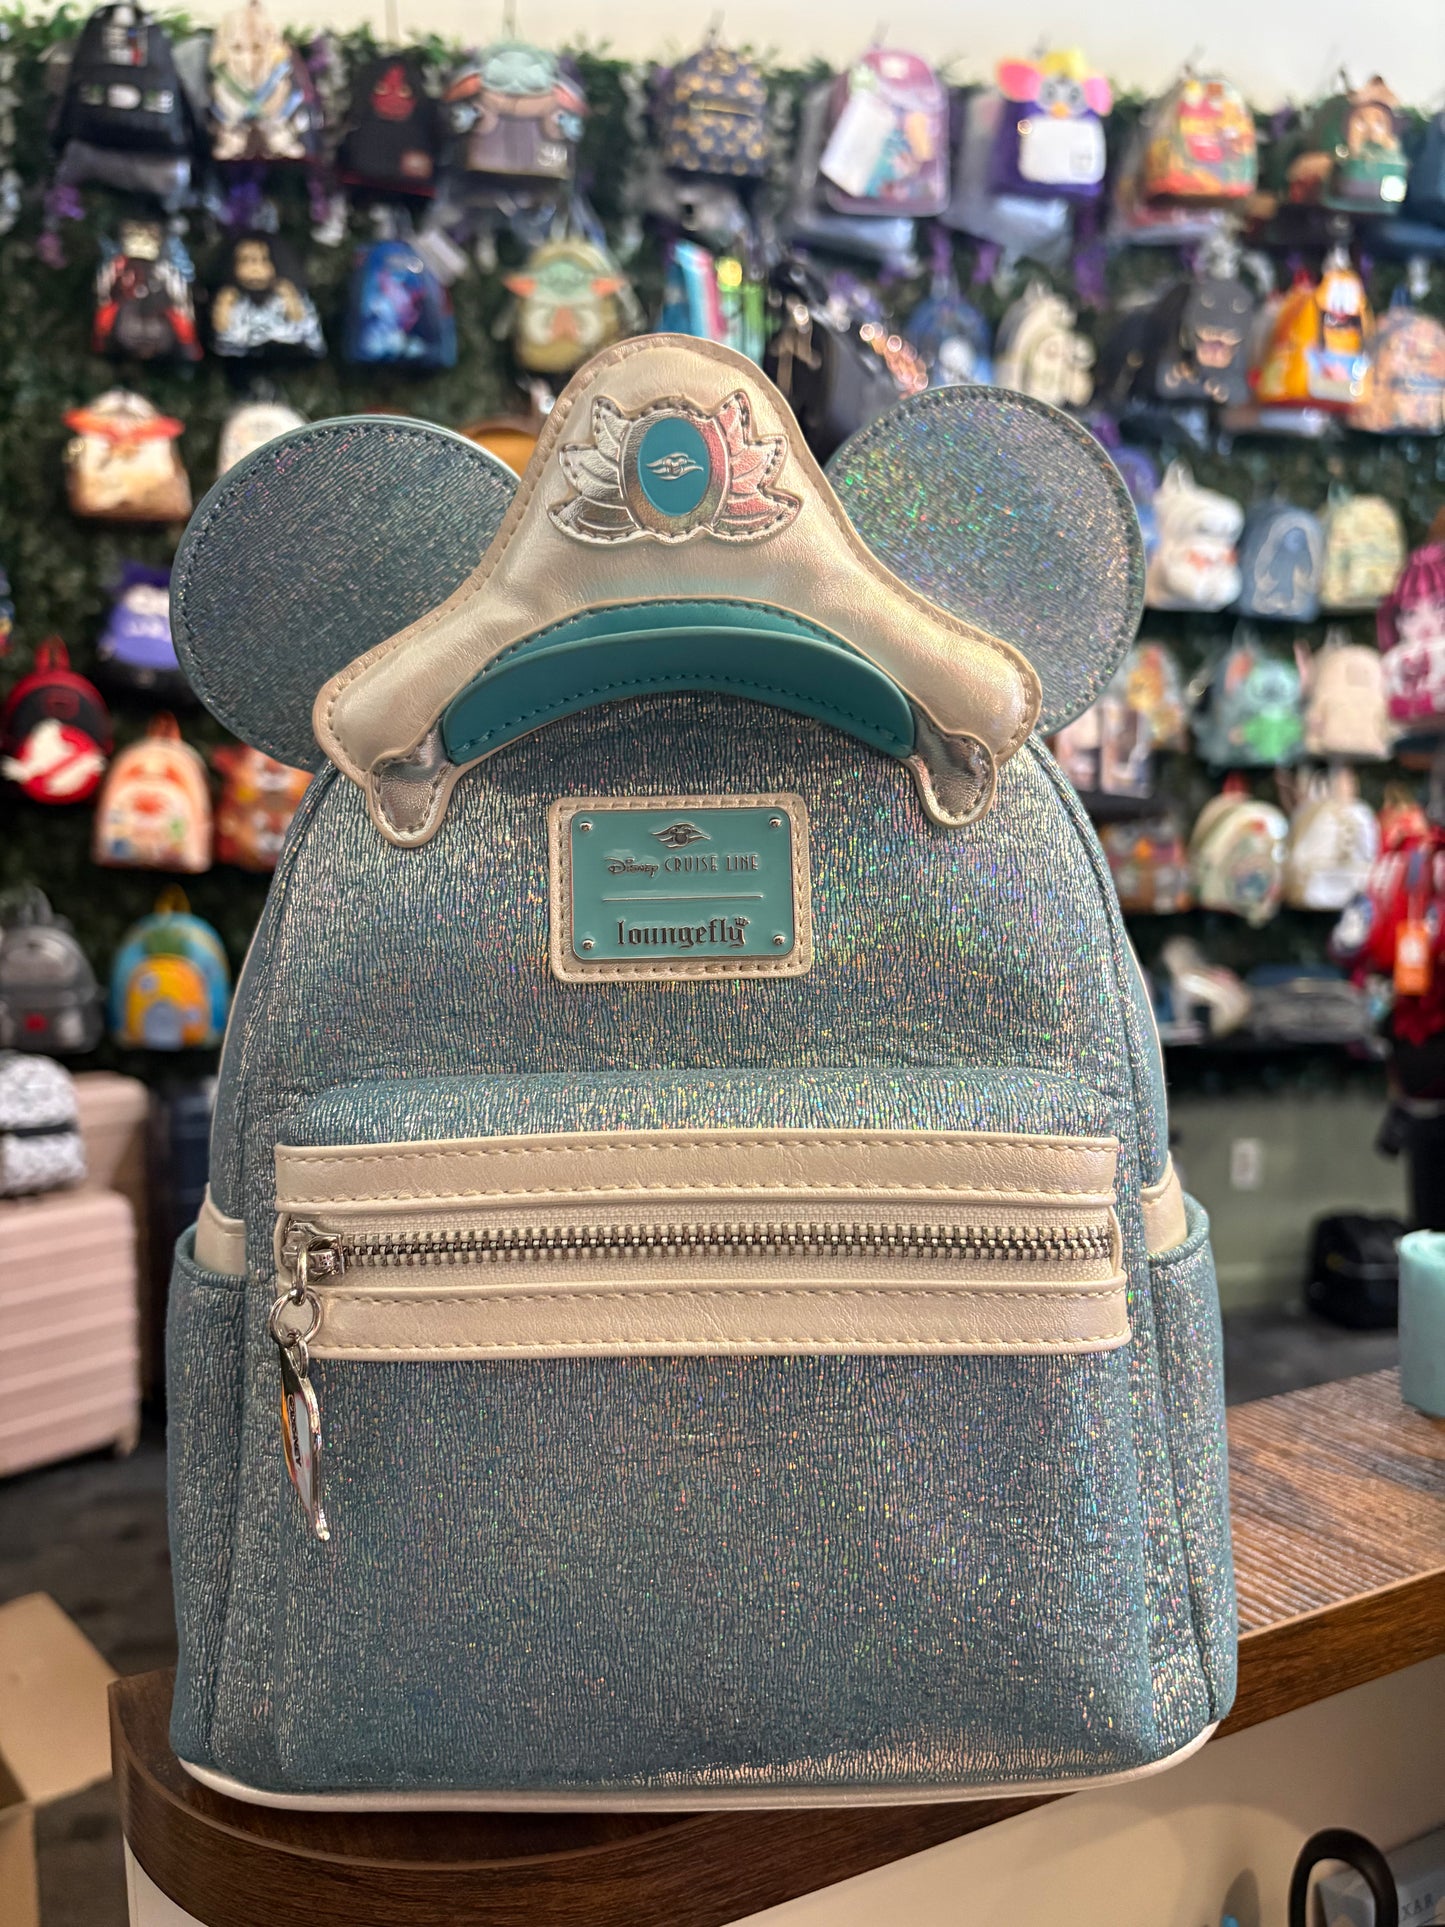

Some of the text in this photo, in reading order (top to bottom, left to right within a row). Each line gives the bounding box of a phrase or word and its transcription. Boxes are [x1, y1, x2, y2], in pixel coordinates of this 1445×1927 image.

[665, 855, 718, 872] CRUISE
[727, 854, 760, 871] LINE
[617, 917, 750, 948] loungefly
